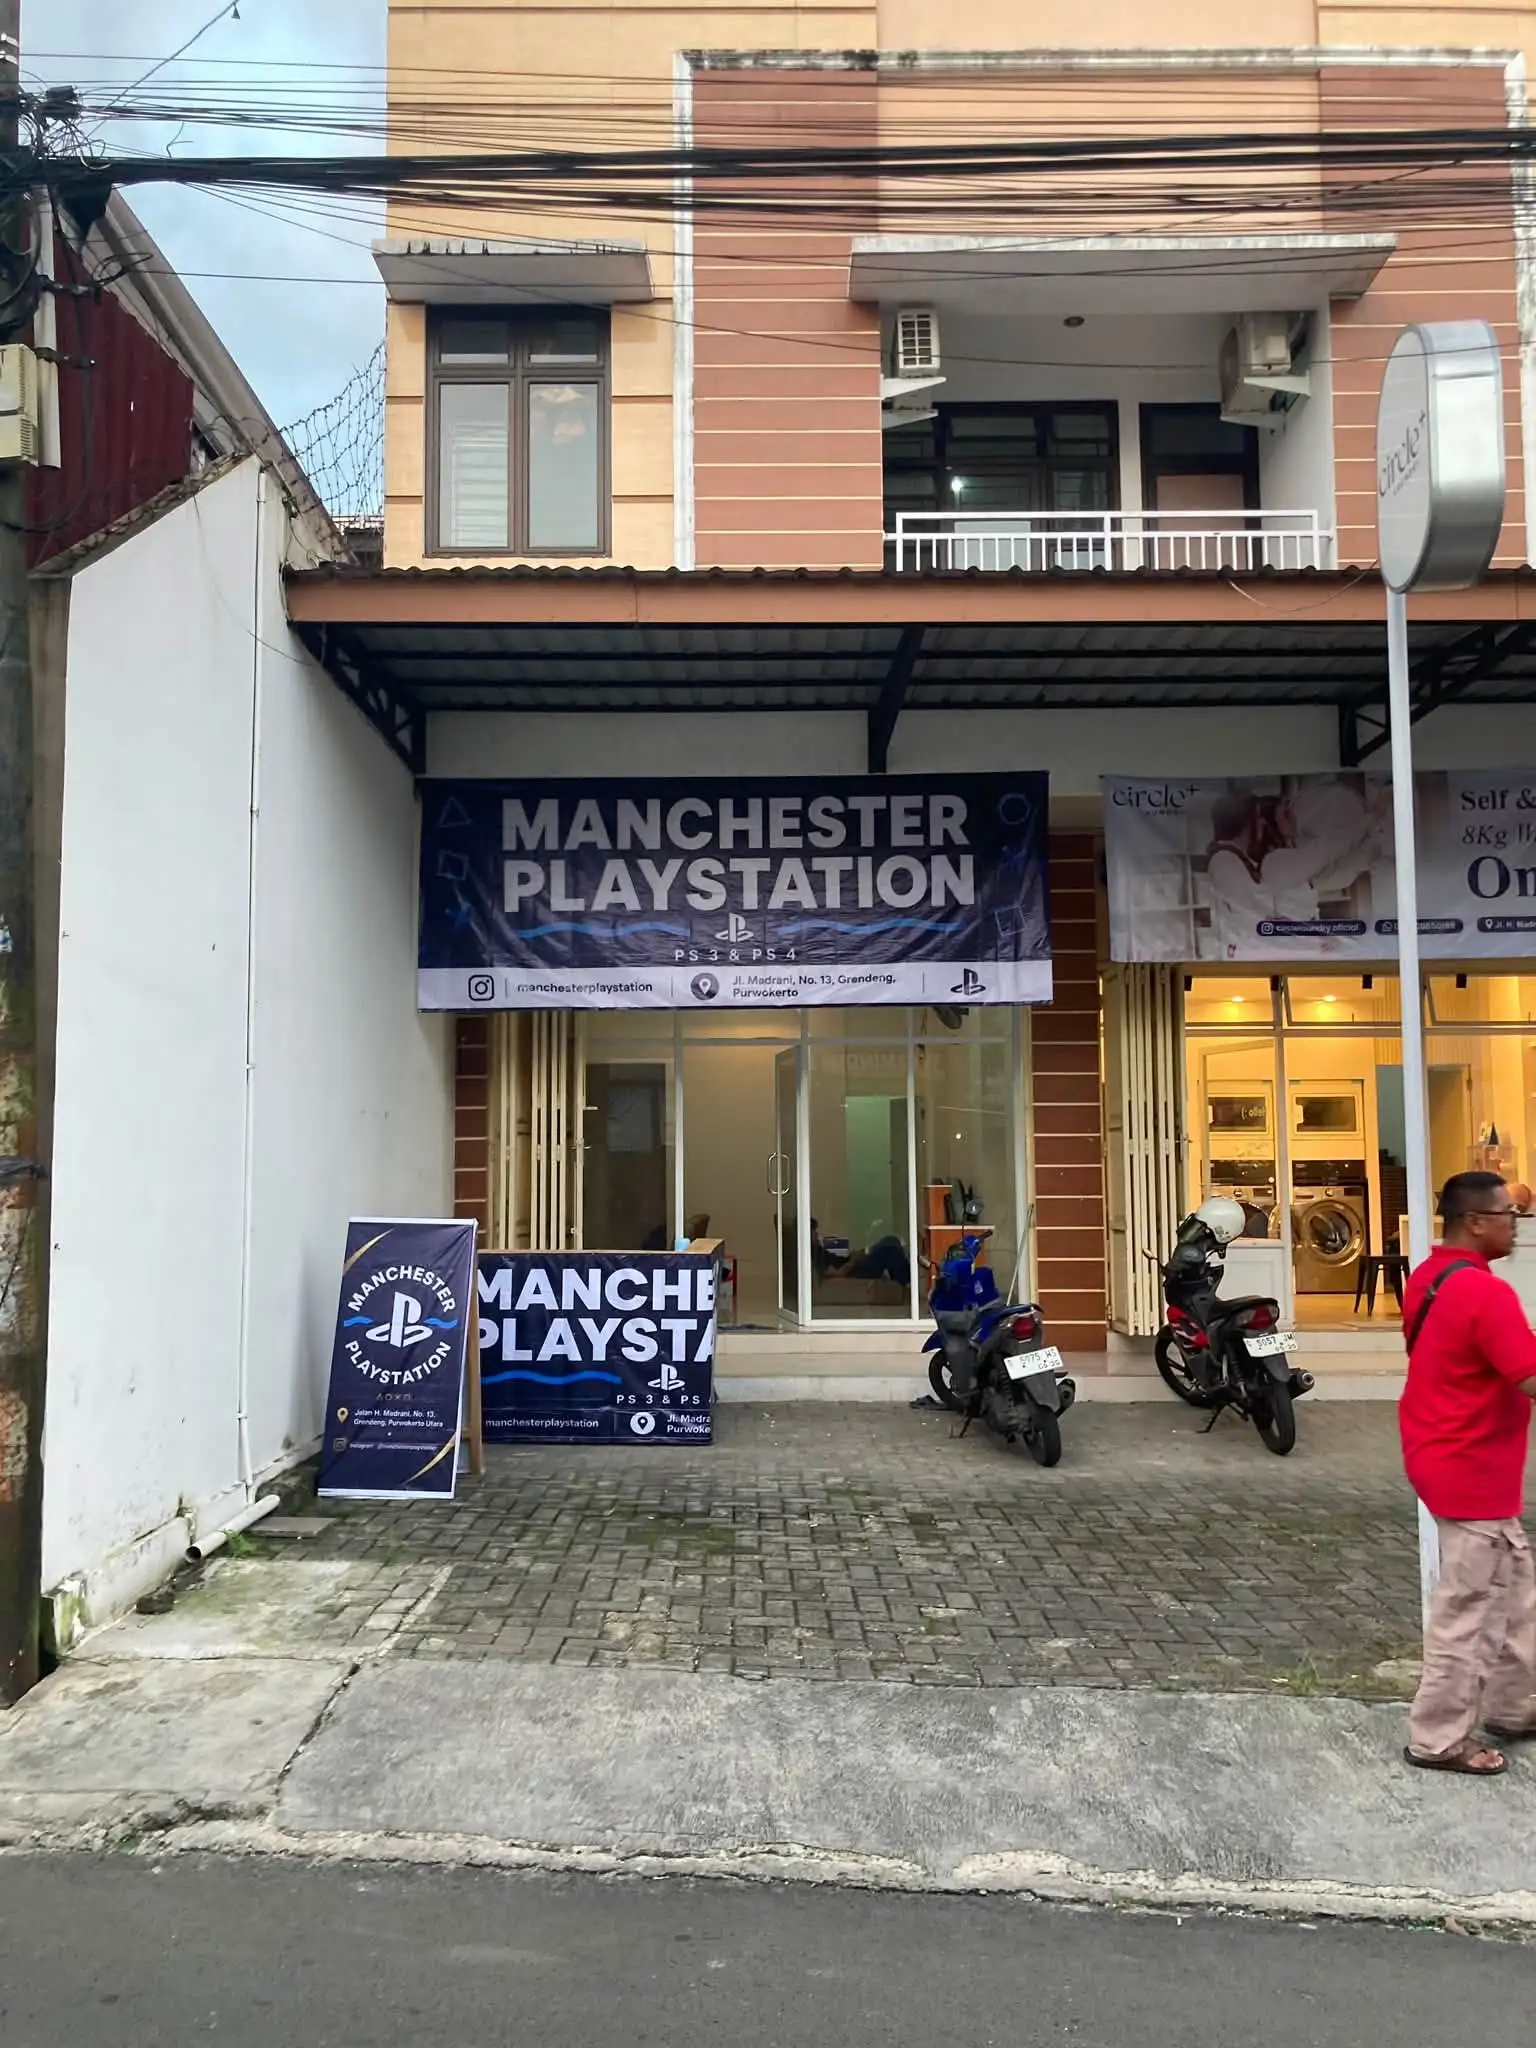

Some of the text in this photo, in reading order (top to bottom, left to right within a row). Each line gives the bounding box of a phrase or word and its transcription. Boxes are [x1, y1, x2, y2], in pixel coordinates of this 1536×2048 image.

[1461, 788, 1536, 811] Self &
[502, 795, 970, 850] MANCHESTER
[503, 855, 975, 912] PLAYSTATION
[675, 948, 796, 961] PS 3 & PS 4
[733, 973, 897, 987] Jl. Madrani, No. 13, Grendeng,
[517, 981, 653, 995] manchesterplaystation
[733, 987, 799, 998] Purwokerto
[347, 1265, 456, 1313] MANCHESTER
[345, 1340, 452, 1385] PLAYSTATION
[616, 1394, 701, 1405] PS 3 & PS
[485, 1418, 600, 1429] manchesterplaystation
